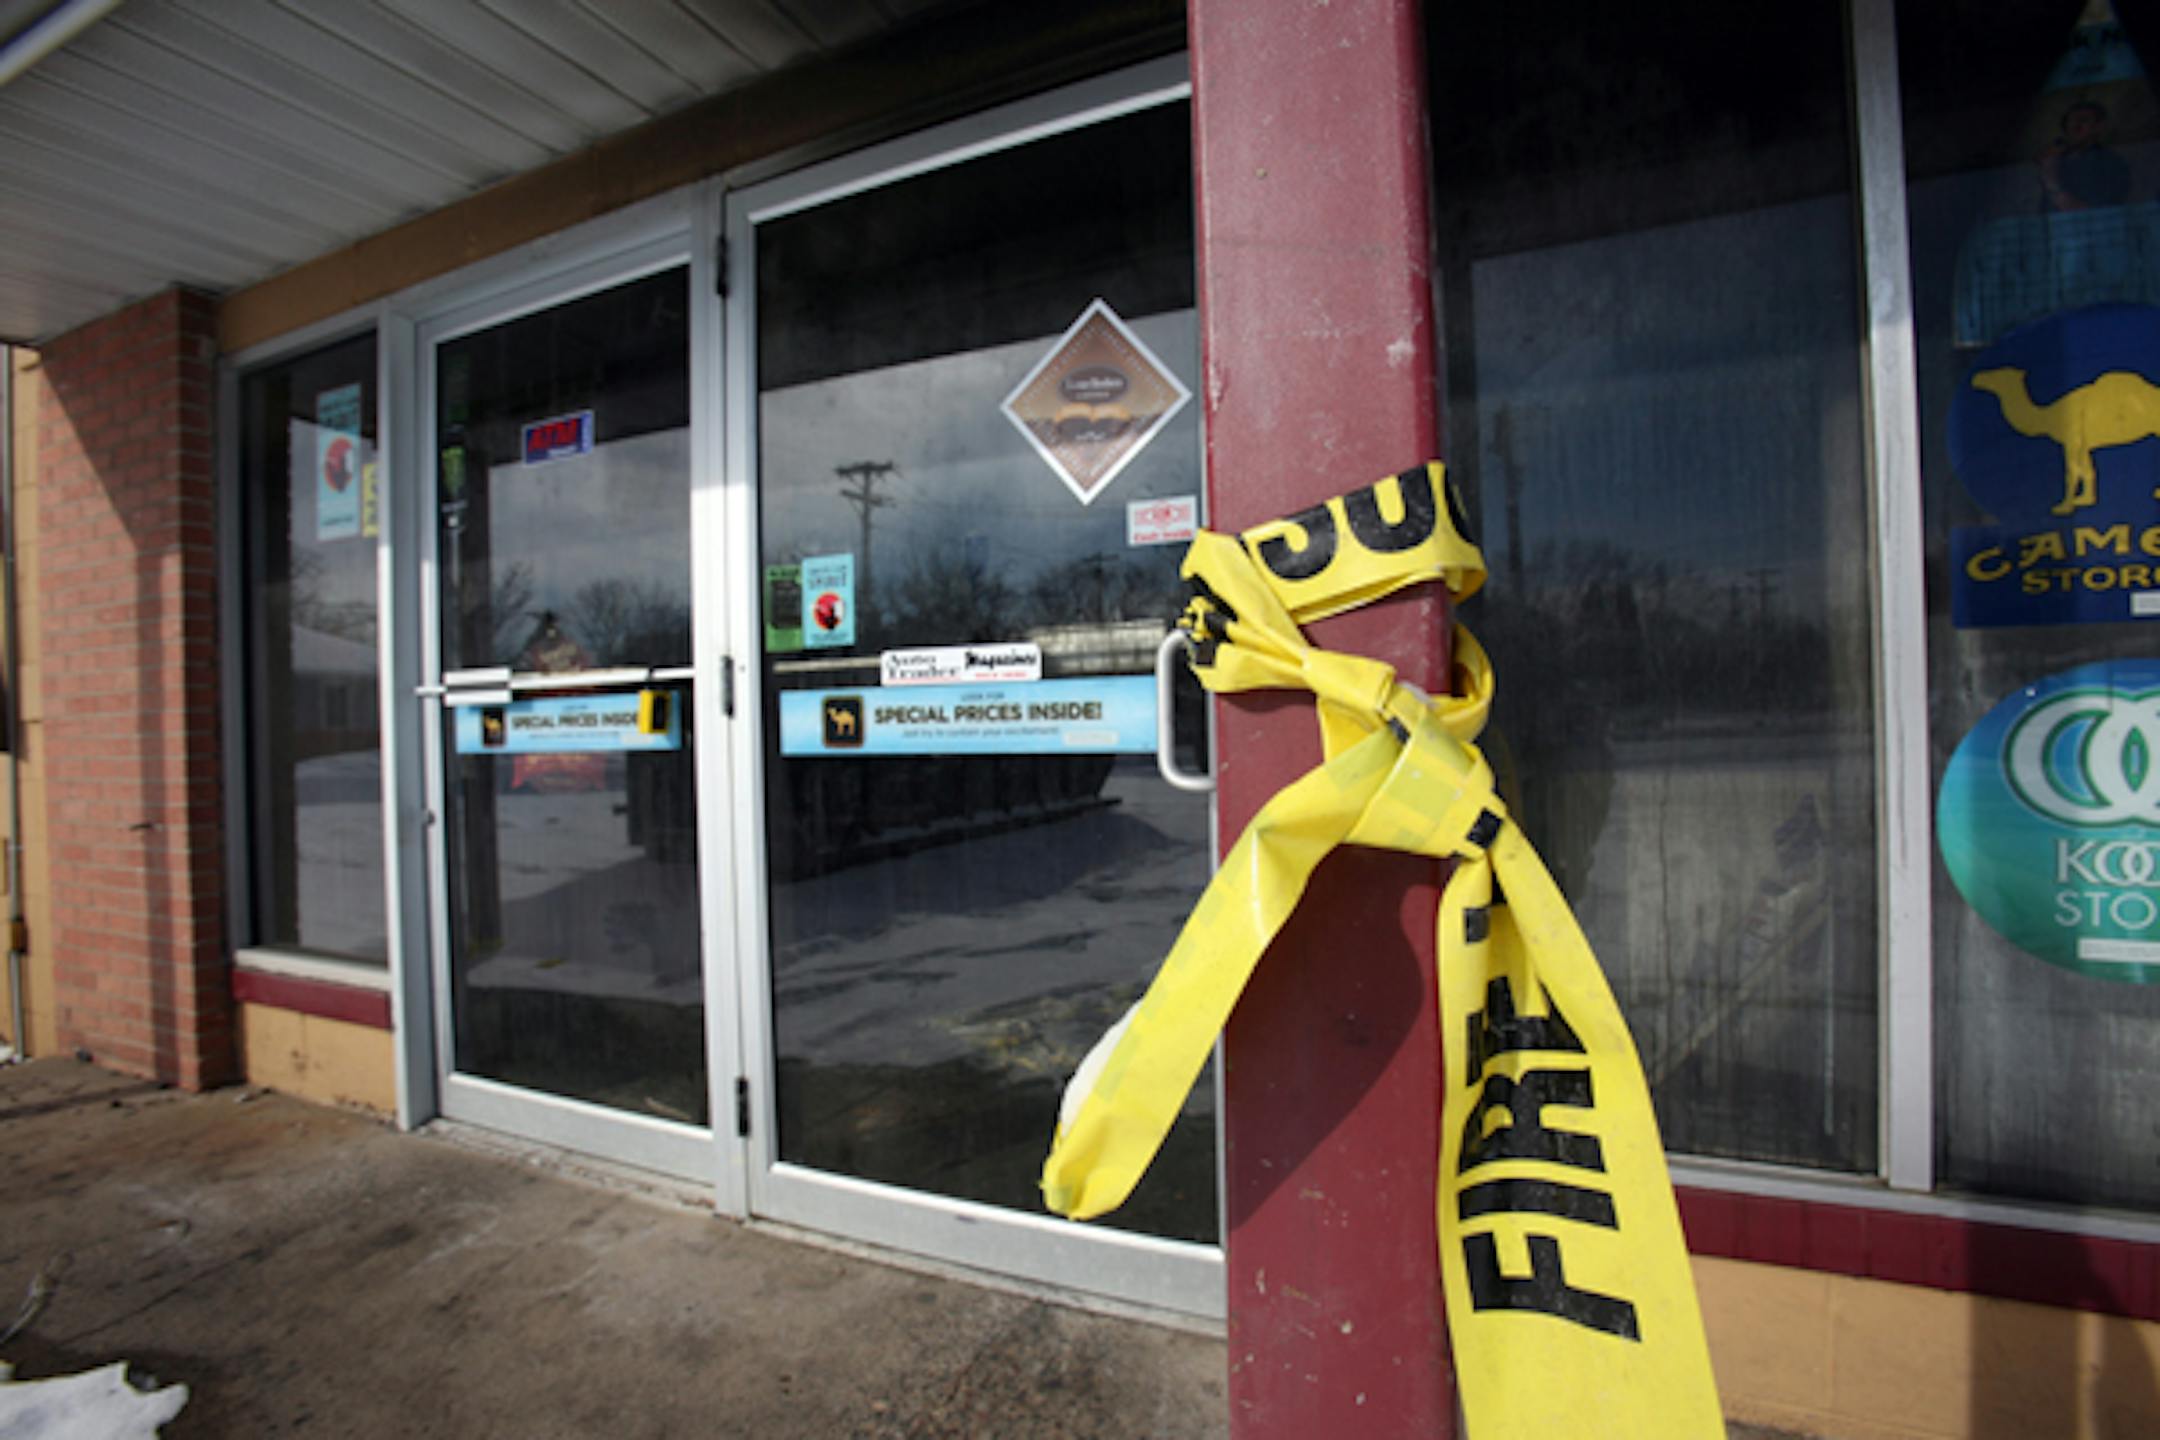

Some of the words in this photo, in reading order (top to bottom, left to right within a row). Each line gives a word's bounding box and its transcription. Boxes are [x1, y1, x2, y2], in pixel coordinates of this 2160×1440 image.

[2021, 564, 2160, 594] STOR
[512, 714, 554, 730] SPECIAL
[558, 712, 598, 728] PRICES
[874, 706, 948, 724] SPECIAL
[954, 704, 1022, 722] PRICES
[1028, 702, 1102, 720] INSIDE!
[2054, 891, 2157, 930] STO
[1459, 976, 1643, 1342] FIRE
